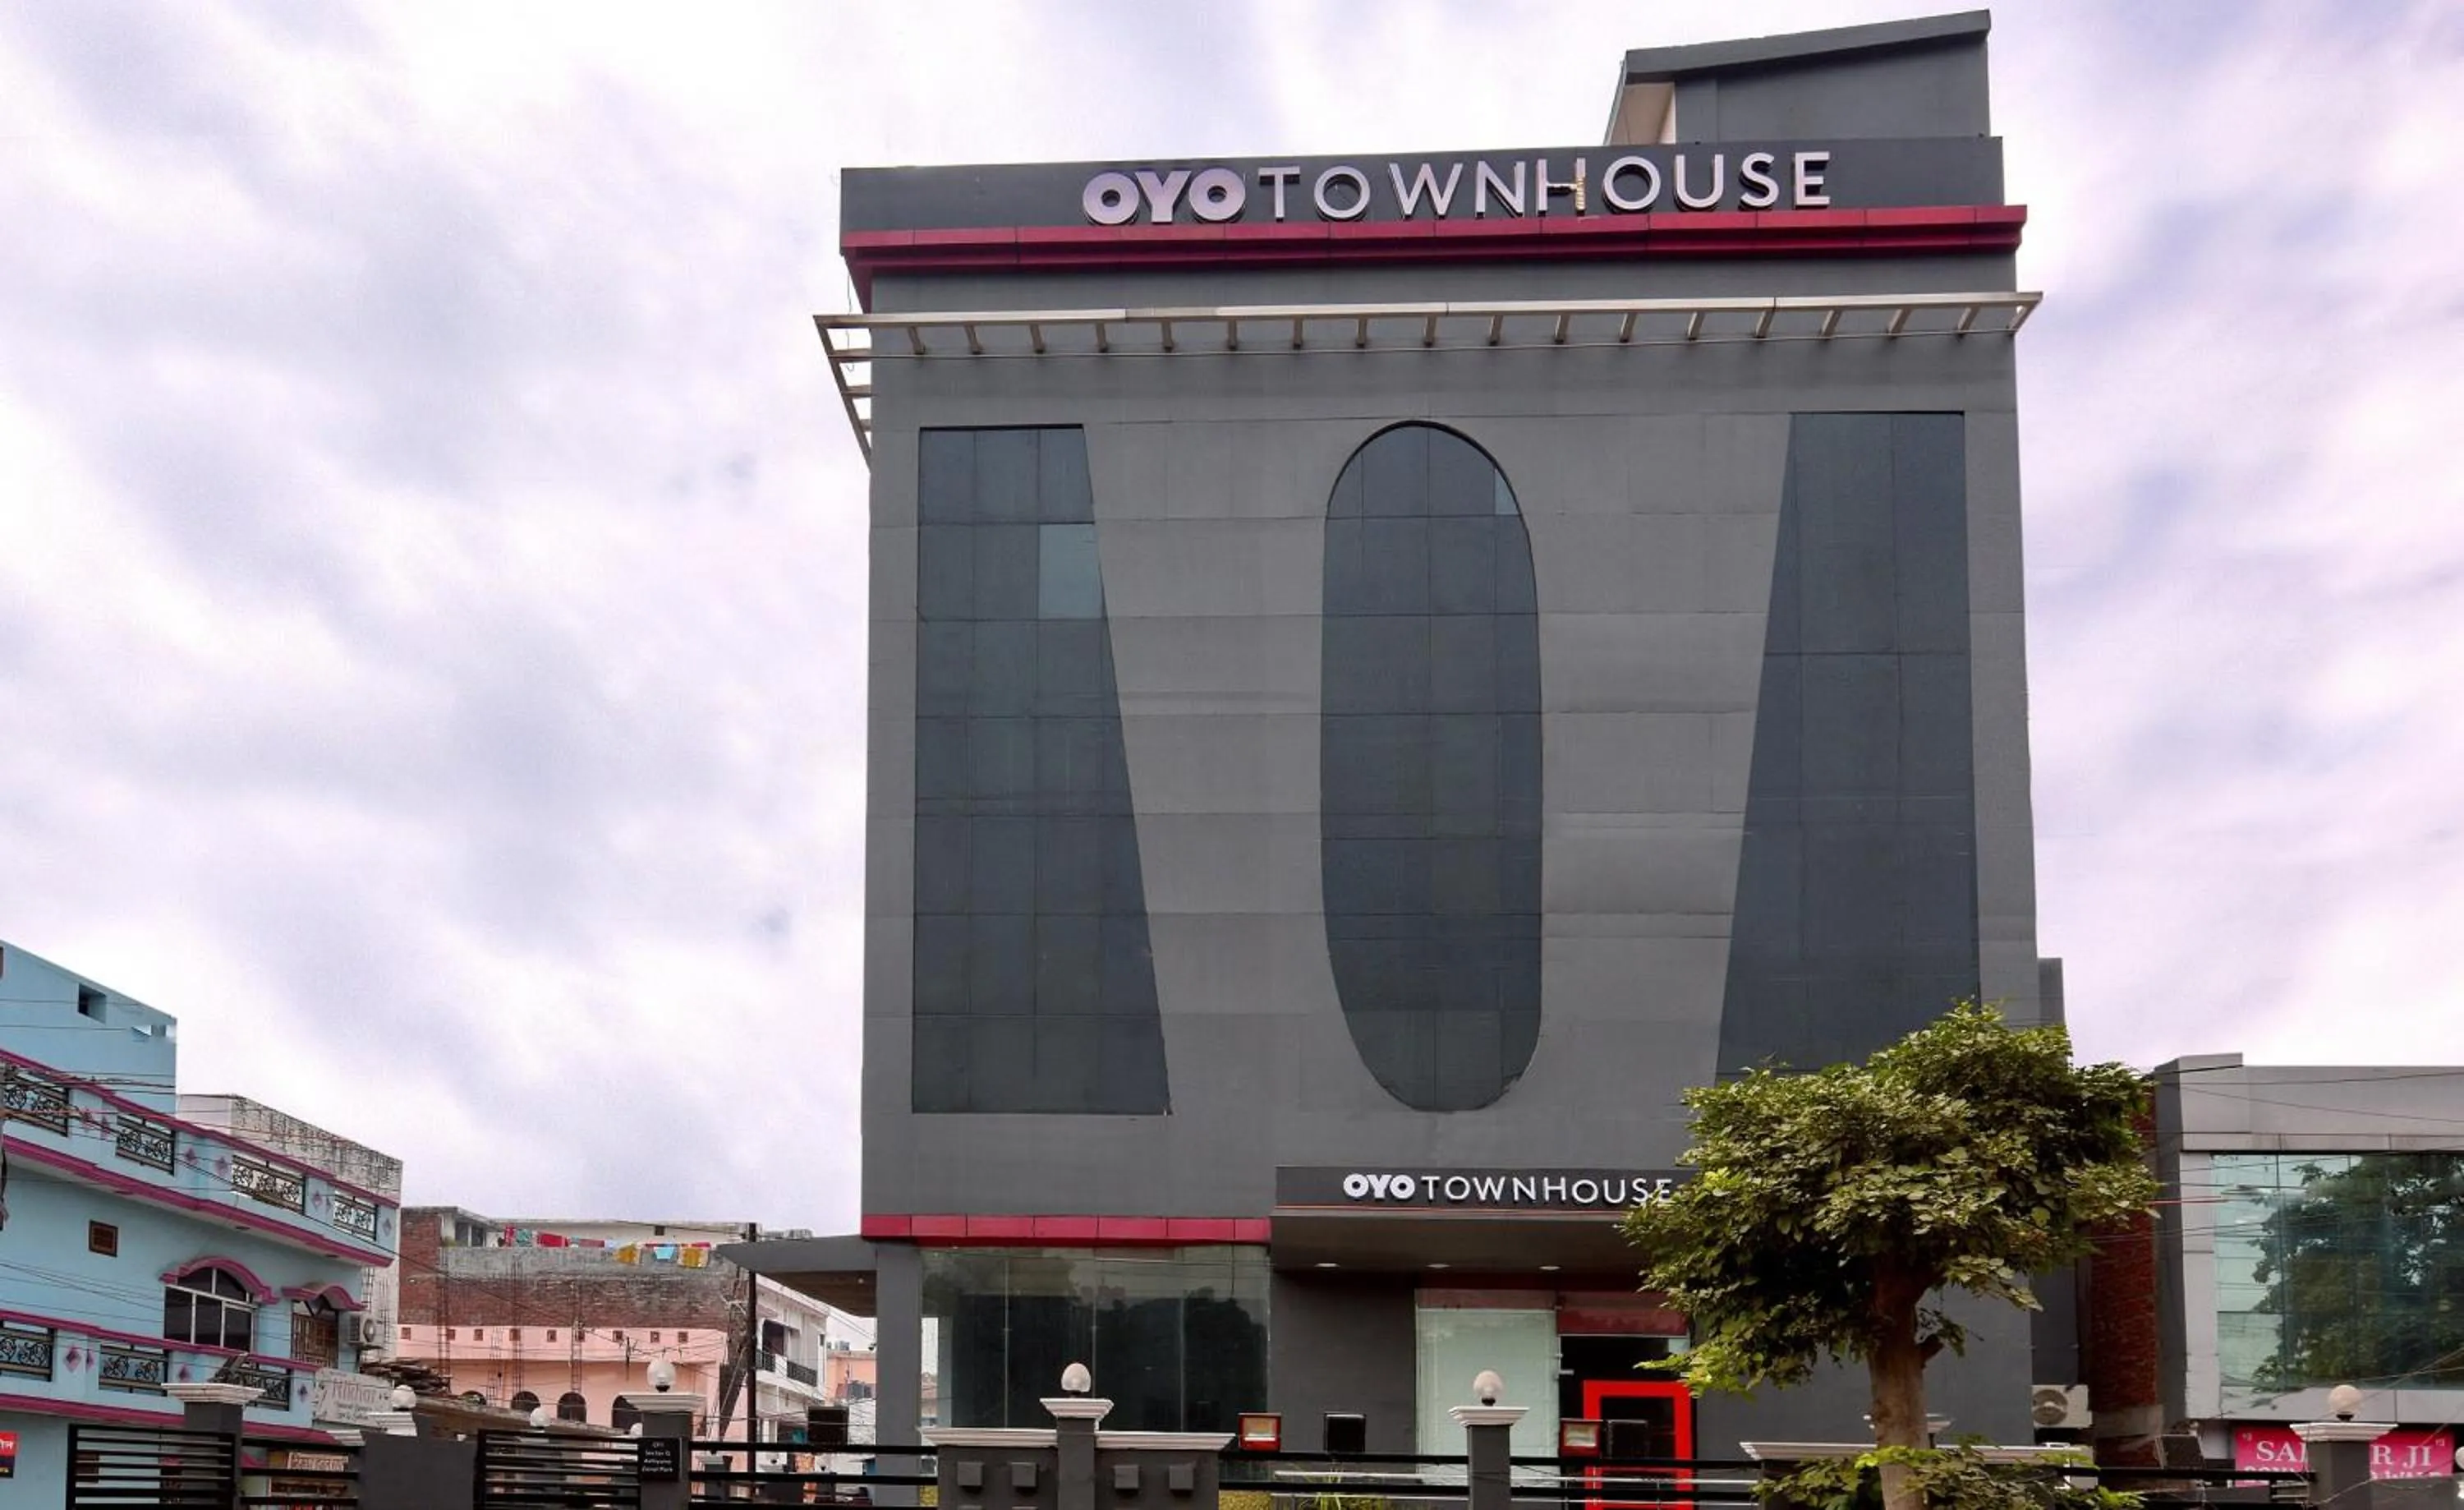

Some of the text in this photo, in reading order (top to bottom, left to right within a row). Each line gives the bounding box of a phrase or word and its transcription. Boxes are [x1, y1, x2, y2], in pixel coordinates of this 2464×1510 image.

[1083, 151, 1831, 226] OYO TOWNHOUSE
[1342, 1173, 1673, 1205] OYO TOWNHOUSE
[2402, 1444, 2433, 1469] JI
